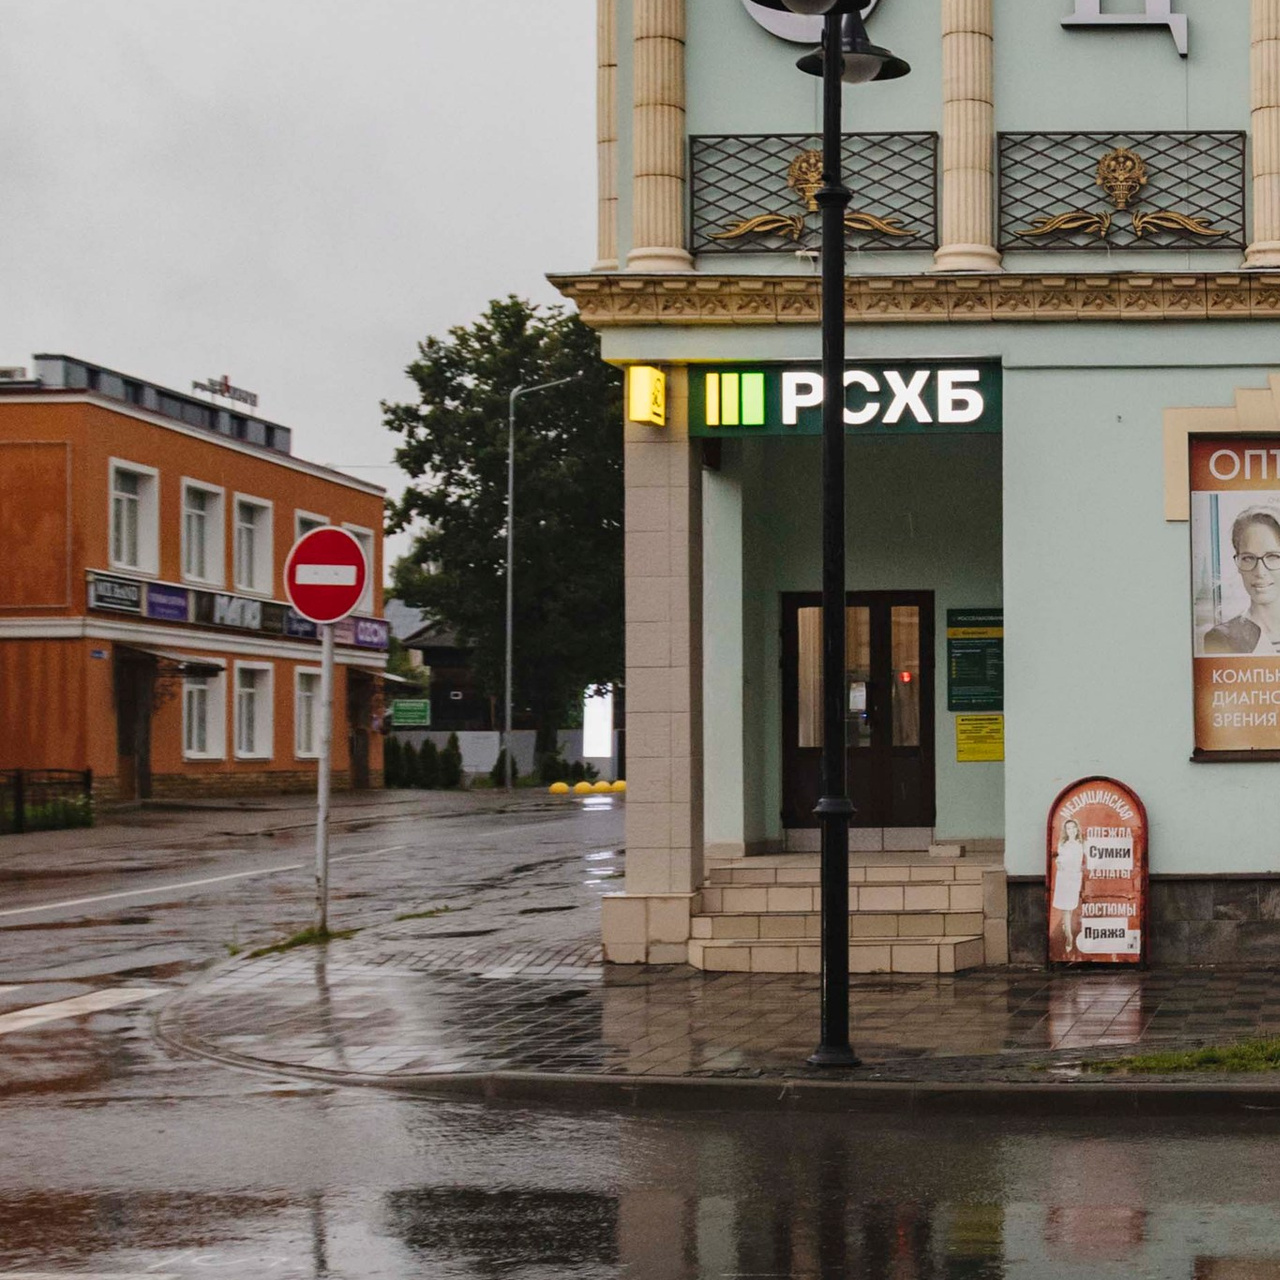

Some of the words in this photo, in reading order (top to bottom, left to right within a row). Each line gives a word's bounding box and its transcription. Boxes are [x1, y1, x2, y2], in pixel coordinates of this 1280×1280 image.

[782, 370, 984, 425] РСХБ
[1212, 712, 1277, 727] ЗРЕНИЯ
[1060, 790, 1134, 820] МЕДИЦИНСКАЯ
[1089, 845, 1131, 860] Сумки
[1082, 903, 1136, 917] КОСТЮМЫ
[1084, 926, 1125, 940] Пряжа
